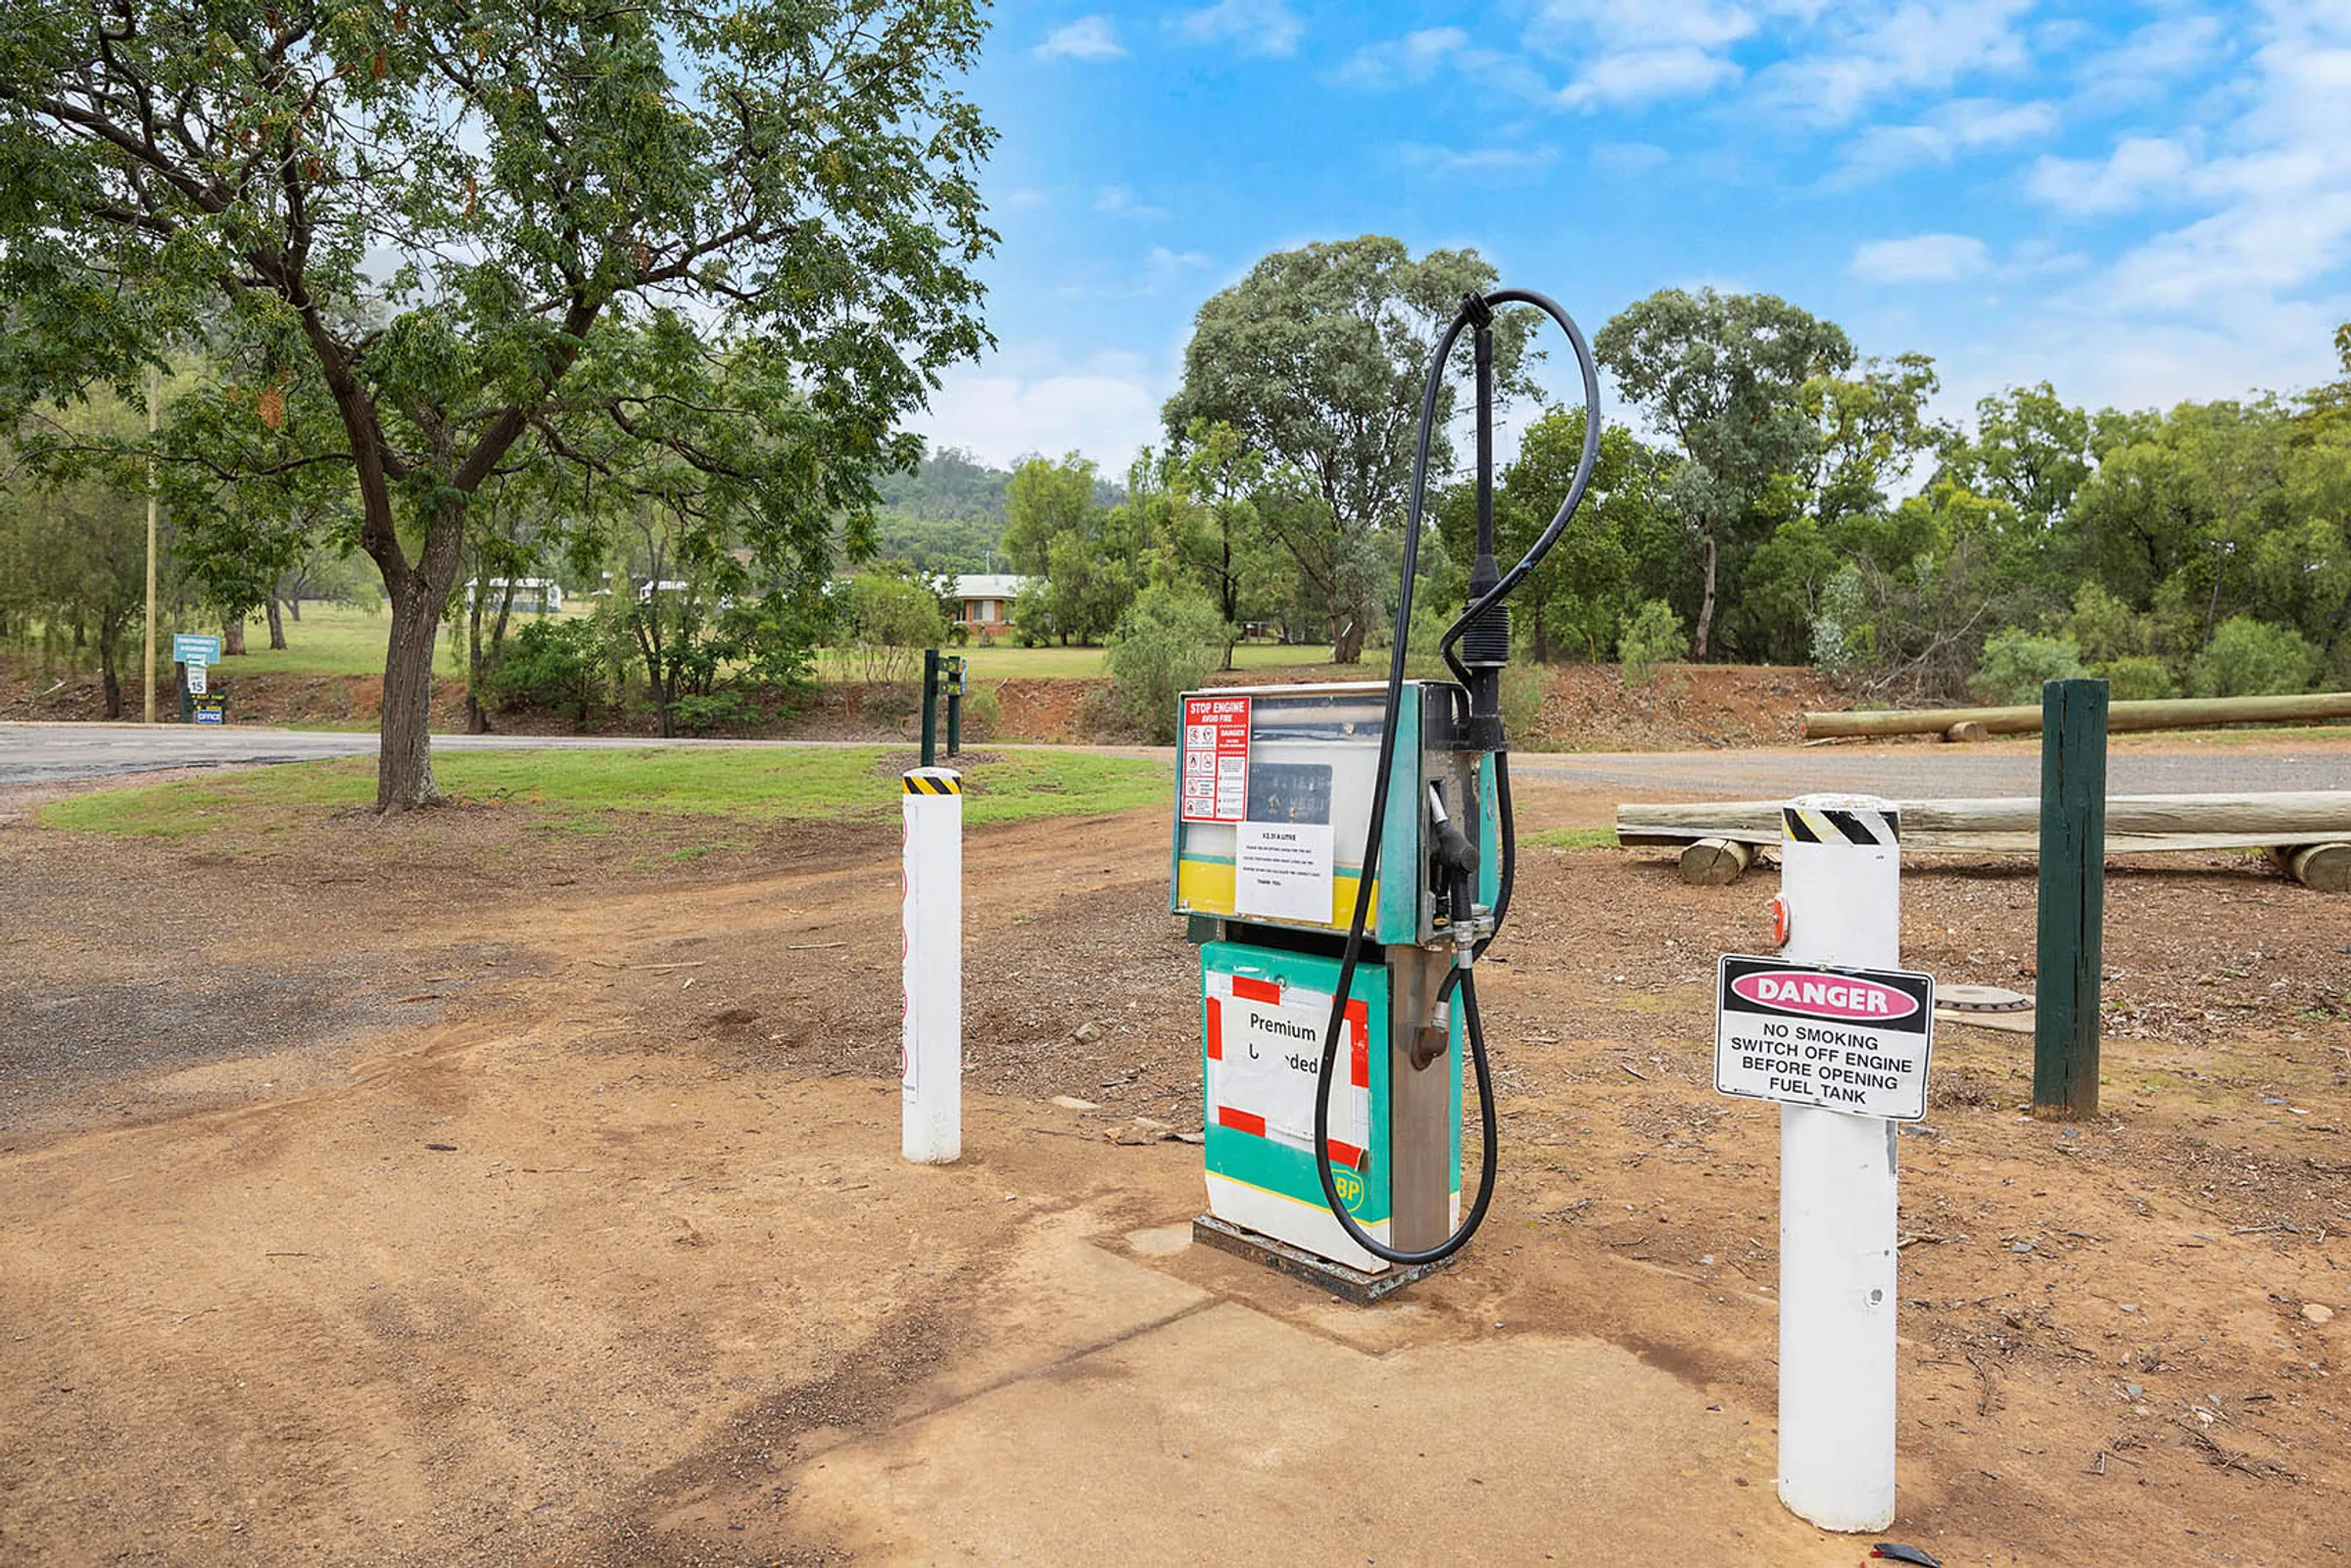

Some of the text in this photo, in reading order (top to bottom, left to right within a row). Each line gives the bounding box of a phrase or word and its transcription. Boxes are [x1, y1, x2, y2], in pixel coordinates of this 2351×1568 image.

[192, 682, 204, 691] 15
[1190, 701, 1244, 714] STOP ENGINE
[1757, 978, 1889, 1014] DANGER
[1250, 1013, 1317, 1041] Premium
[1763, 1023, 1879, 1051] NO SMOKING
[1731, 1036, 1912, 1073] SWITCH OFF ENGINE
[1743, 1057, 1897, 1090] BEFORE OPENING
[1770, 1077, 1866, 1105] FUEL TANK
[1335, 1176, 1361, 1201] BP
